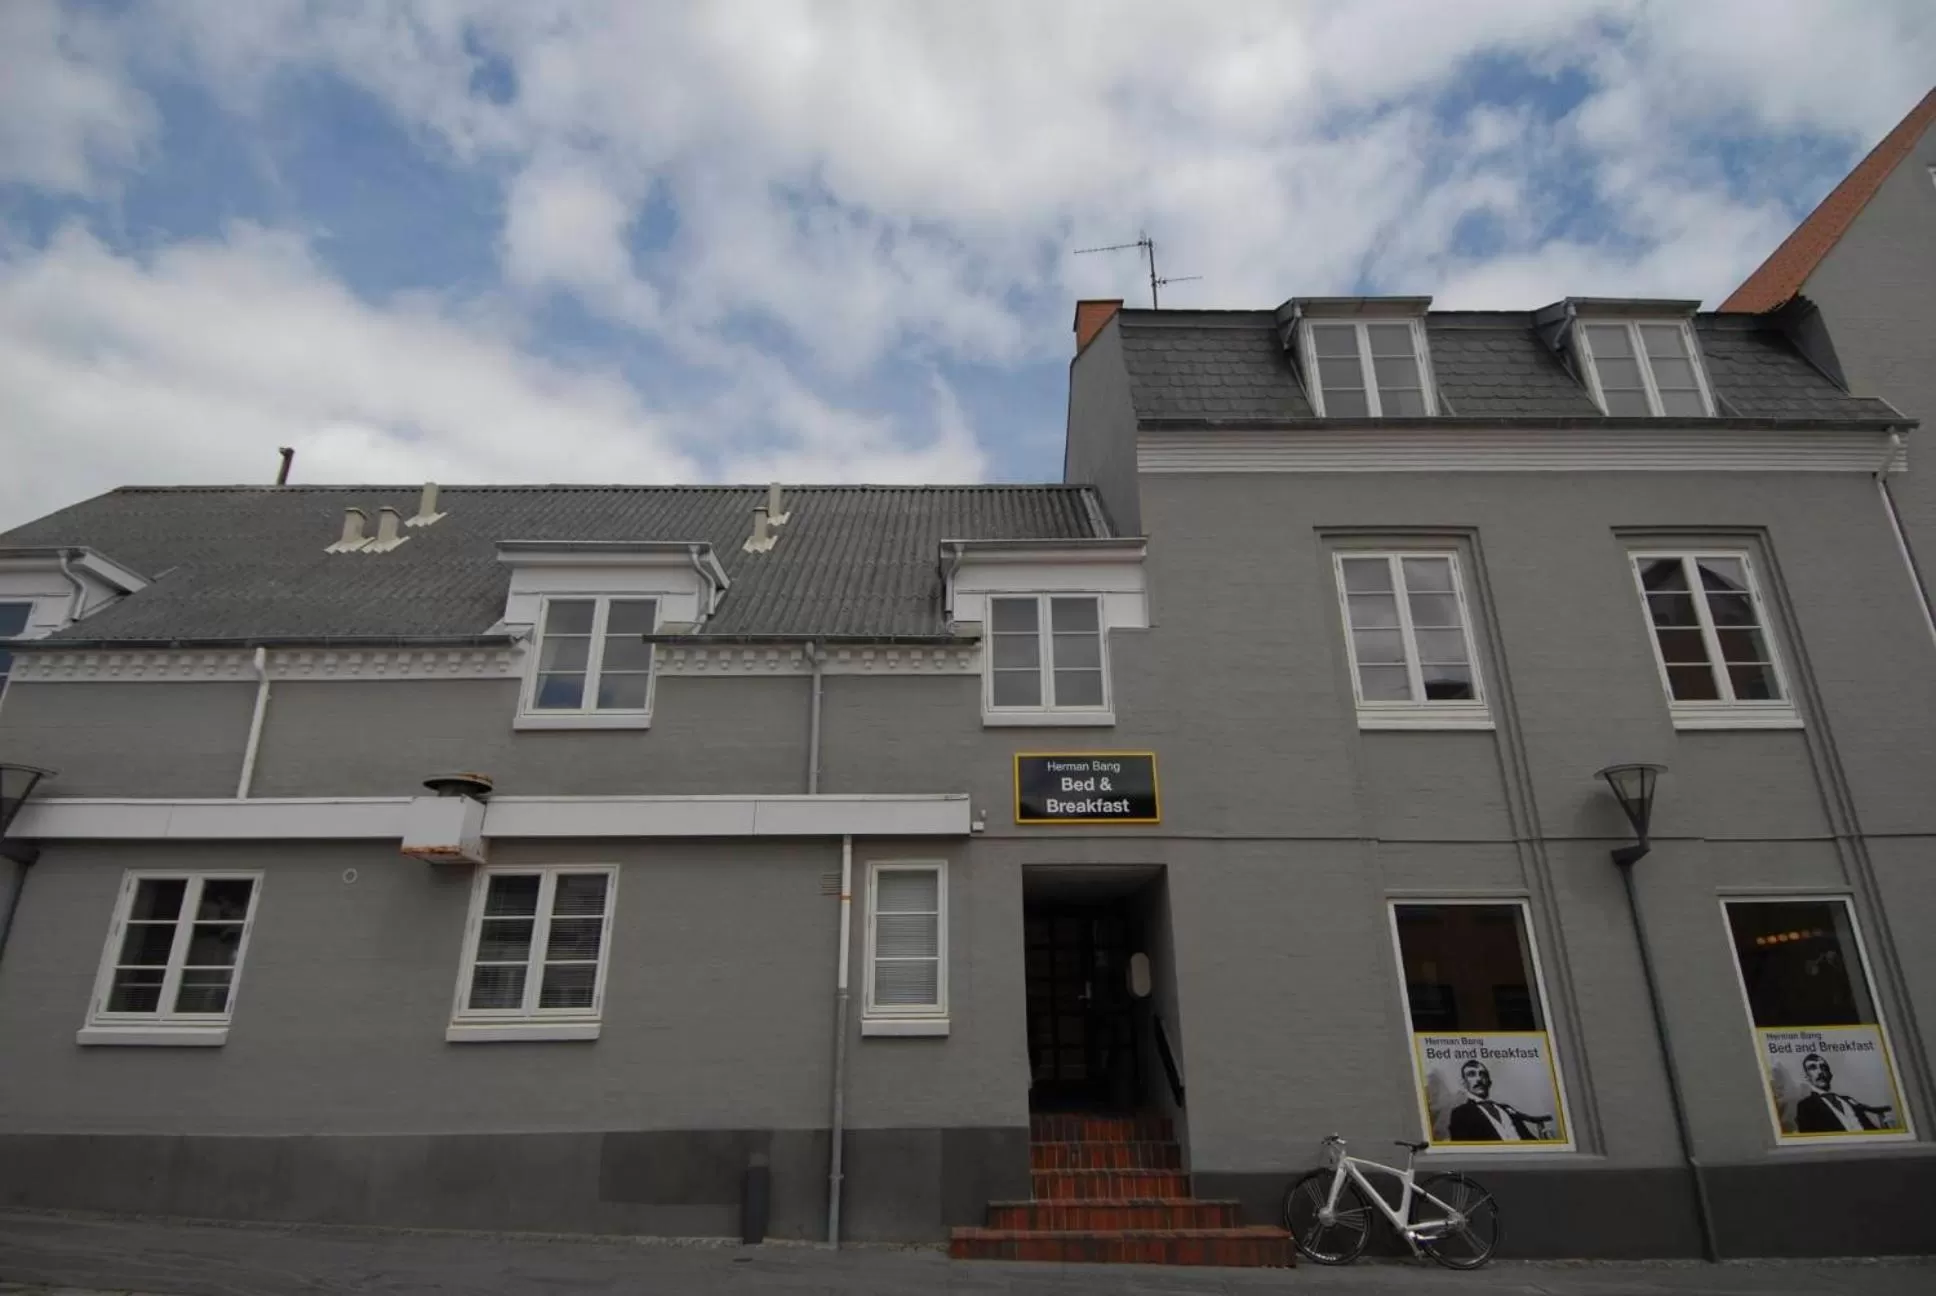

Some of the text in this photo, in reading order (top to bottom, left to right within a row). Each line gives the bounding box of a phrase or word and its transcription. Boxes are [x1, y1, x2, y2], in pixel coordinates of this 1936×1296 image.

[1047, 761, 1120, 773] Herman Bang
[1061, 777, 1112, 791] Bed &
[1046, 798, 1130, 813] Breakfast
[1425, 1037, 1484, 1046] Herman Bang
[1768, 1040, 1875, 1054] Bed and Breakfast
[1427, 1047, 1539, 1059] Bed and Breakfast
